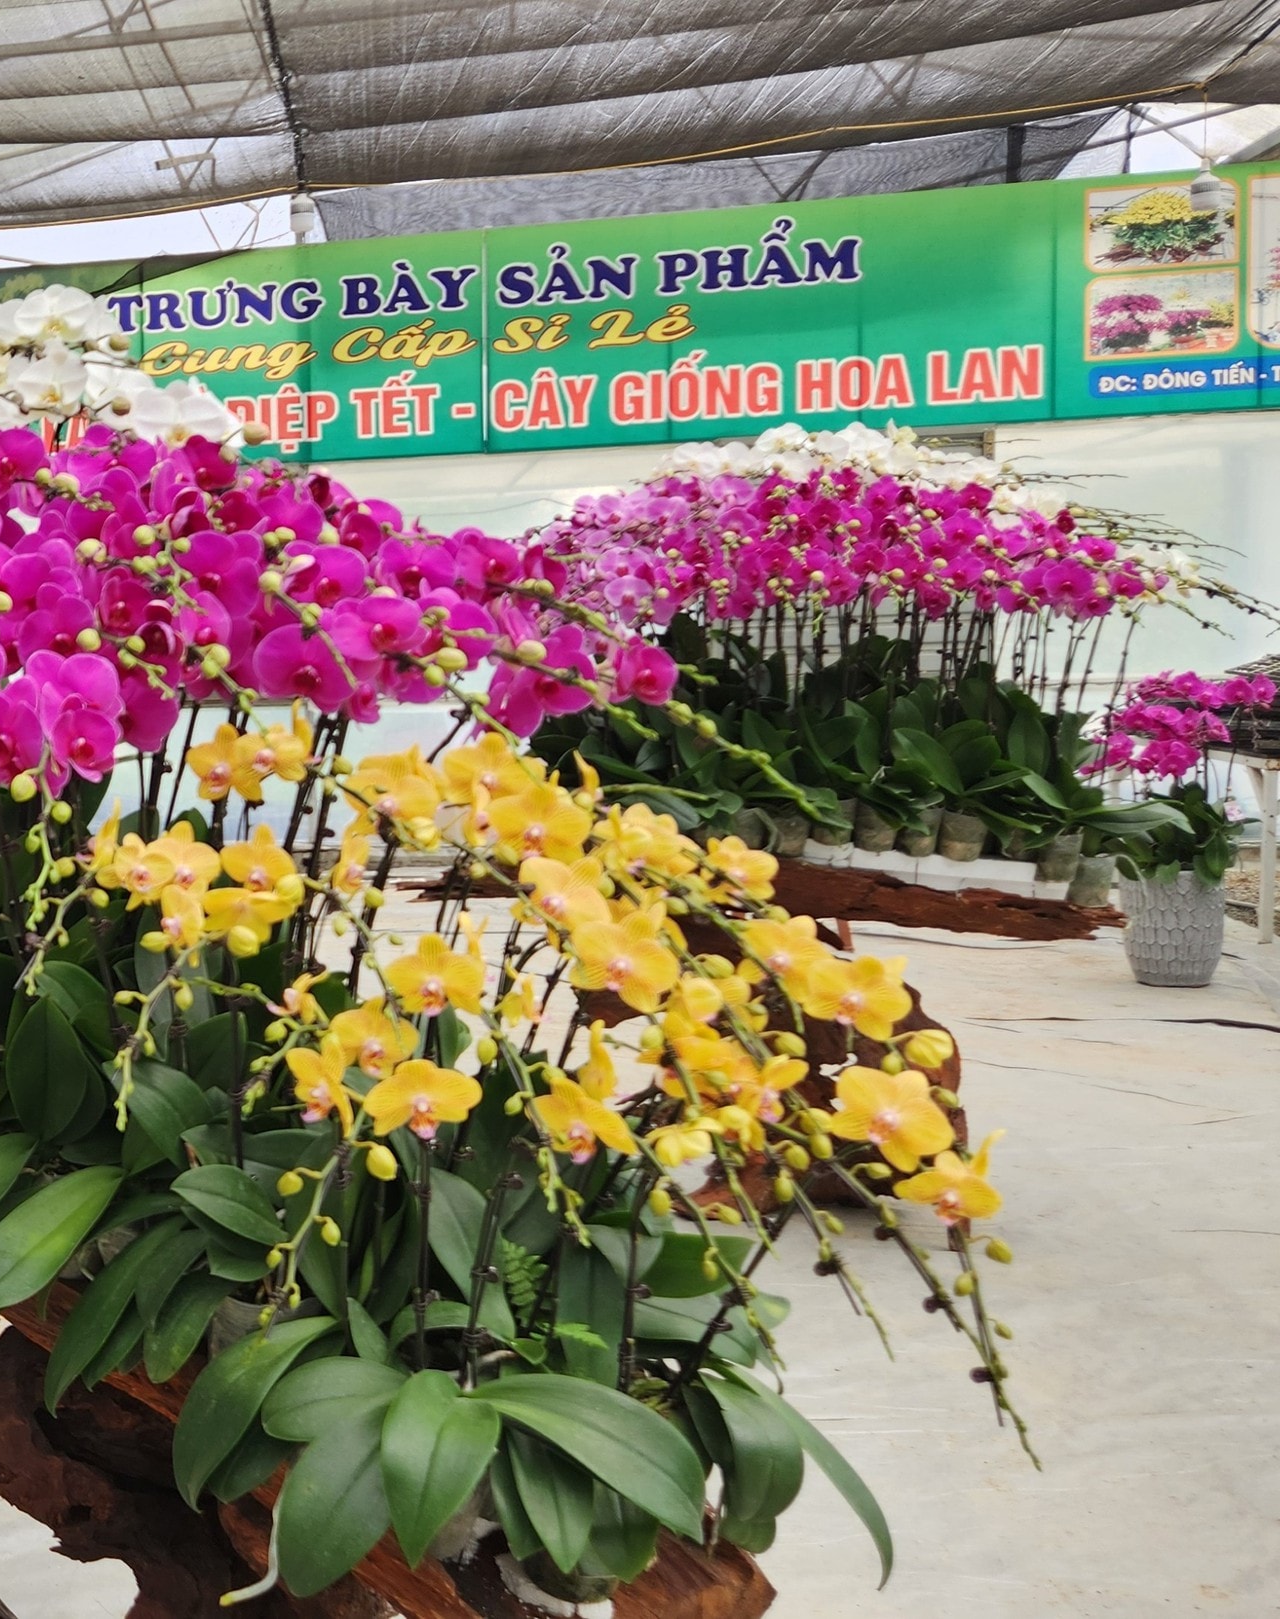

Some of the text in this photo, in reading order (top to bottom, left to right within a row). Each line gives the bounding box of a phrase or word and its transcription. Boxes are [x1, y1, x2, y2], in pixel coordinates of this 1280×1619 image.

[107, 217, 861, 333] TRƯNG BÀY SẢN PHẨM
[140, 341, 317, 380] Cung
[332, 318, 477, 368] Cấp
[588, 304, 696, 350] Lẻ
[1099, 375, 1138, 394] ĐC:
[1142, 368, 1208, 390] ĐÔNG
[1211, 360, 1256, 386] TIẾN
[351, 371, 440, 439] TẾT
[491, 367, 597, 431] CÂY
[610, 350, 782, 423] GIỐNG
[795, 355, 914, 414] HOA
[928, 345, 1044, 404] LAN
